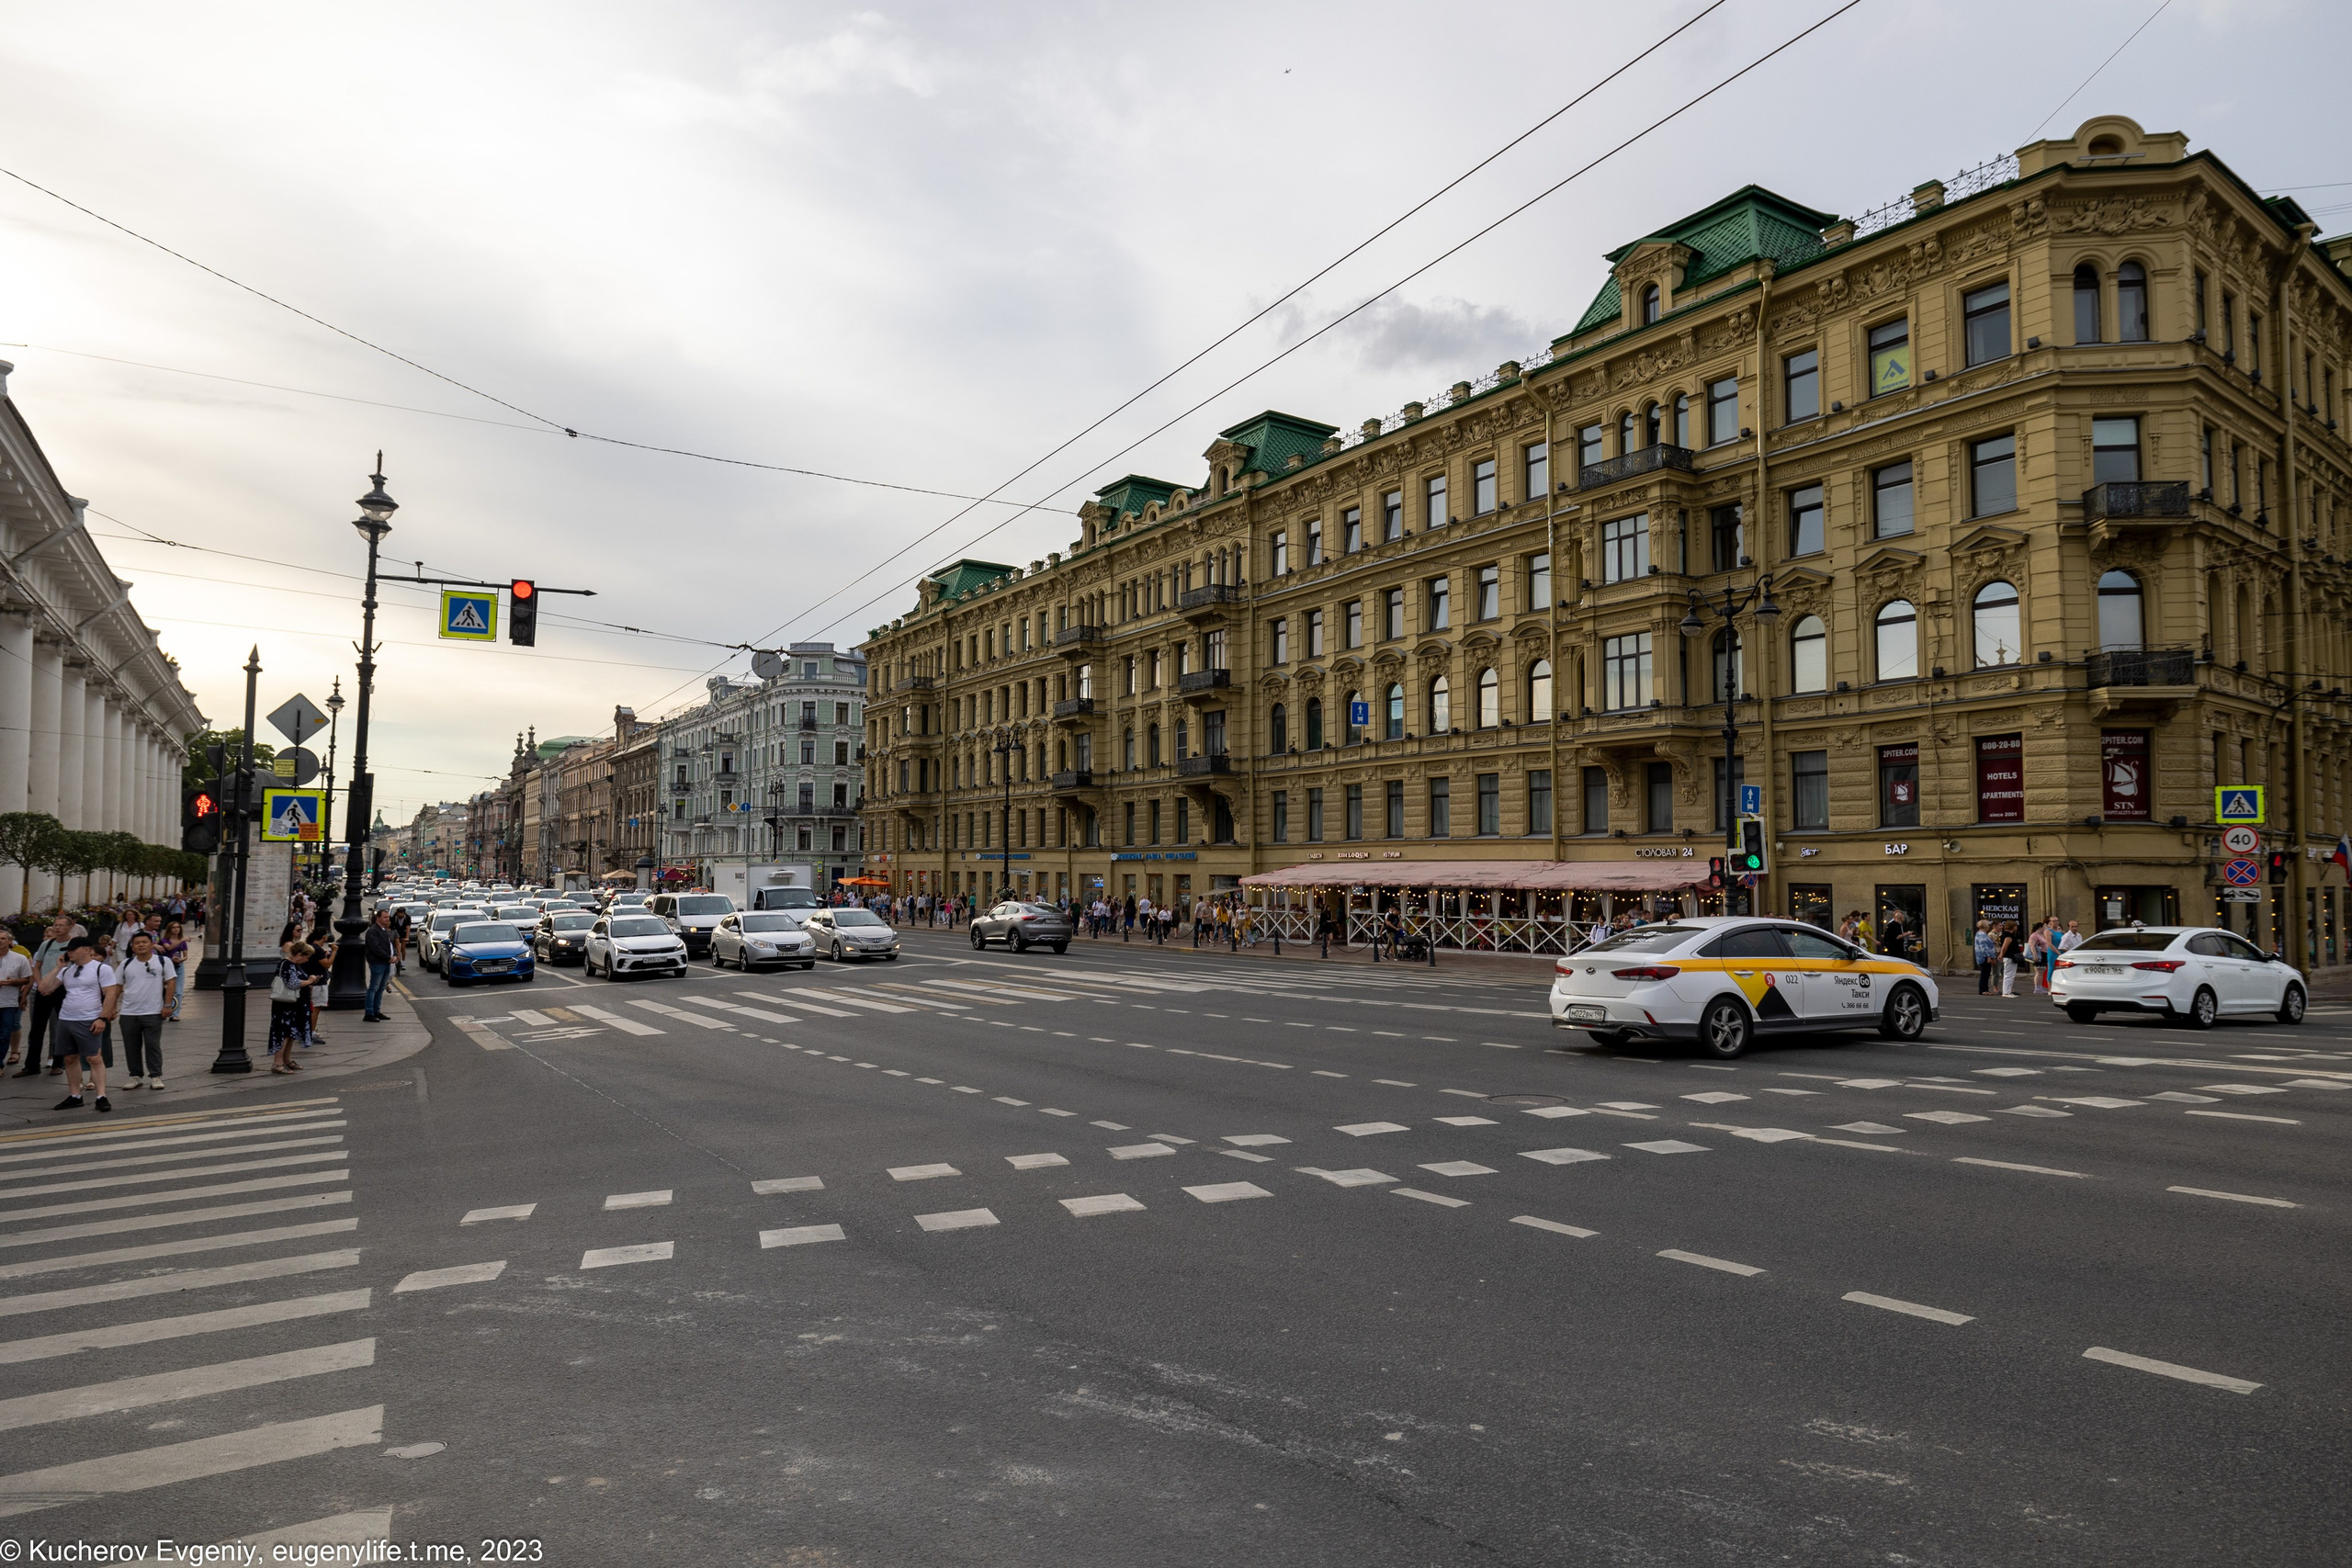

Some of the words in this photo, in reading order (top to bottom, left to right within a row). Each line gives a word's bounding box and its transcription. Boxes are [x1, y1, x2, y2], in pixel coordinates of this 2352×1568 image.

[1982, 739, 2020, 750] 600-20-80
[2101, 736, 2143, 745] 2PITER.COM
[1883, 748, 1918, 758] 2PITER.COM
[1986, 772, 2018, 781] HOTELS
[1982, 791, 2024, 799] APARTMENTS
[2113, 801, 2135, 810] STN
[2230, 834, 2251, 845] 40
[1634, 848, 1678, 857] СТОЛОВАЯ
[1682, 847, 1693, 857] 24
[1884, 844, 1908, 855] БАР
[1785, 975, 1799, 984] 022
[1834, 976, 1858, 987] Яндекс
[1860, 976, 1870, 986] Go
[1851, 989, 1870, 998] Такси
[1570, 1009, 1593, 1019] М022ВН
